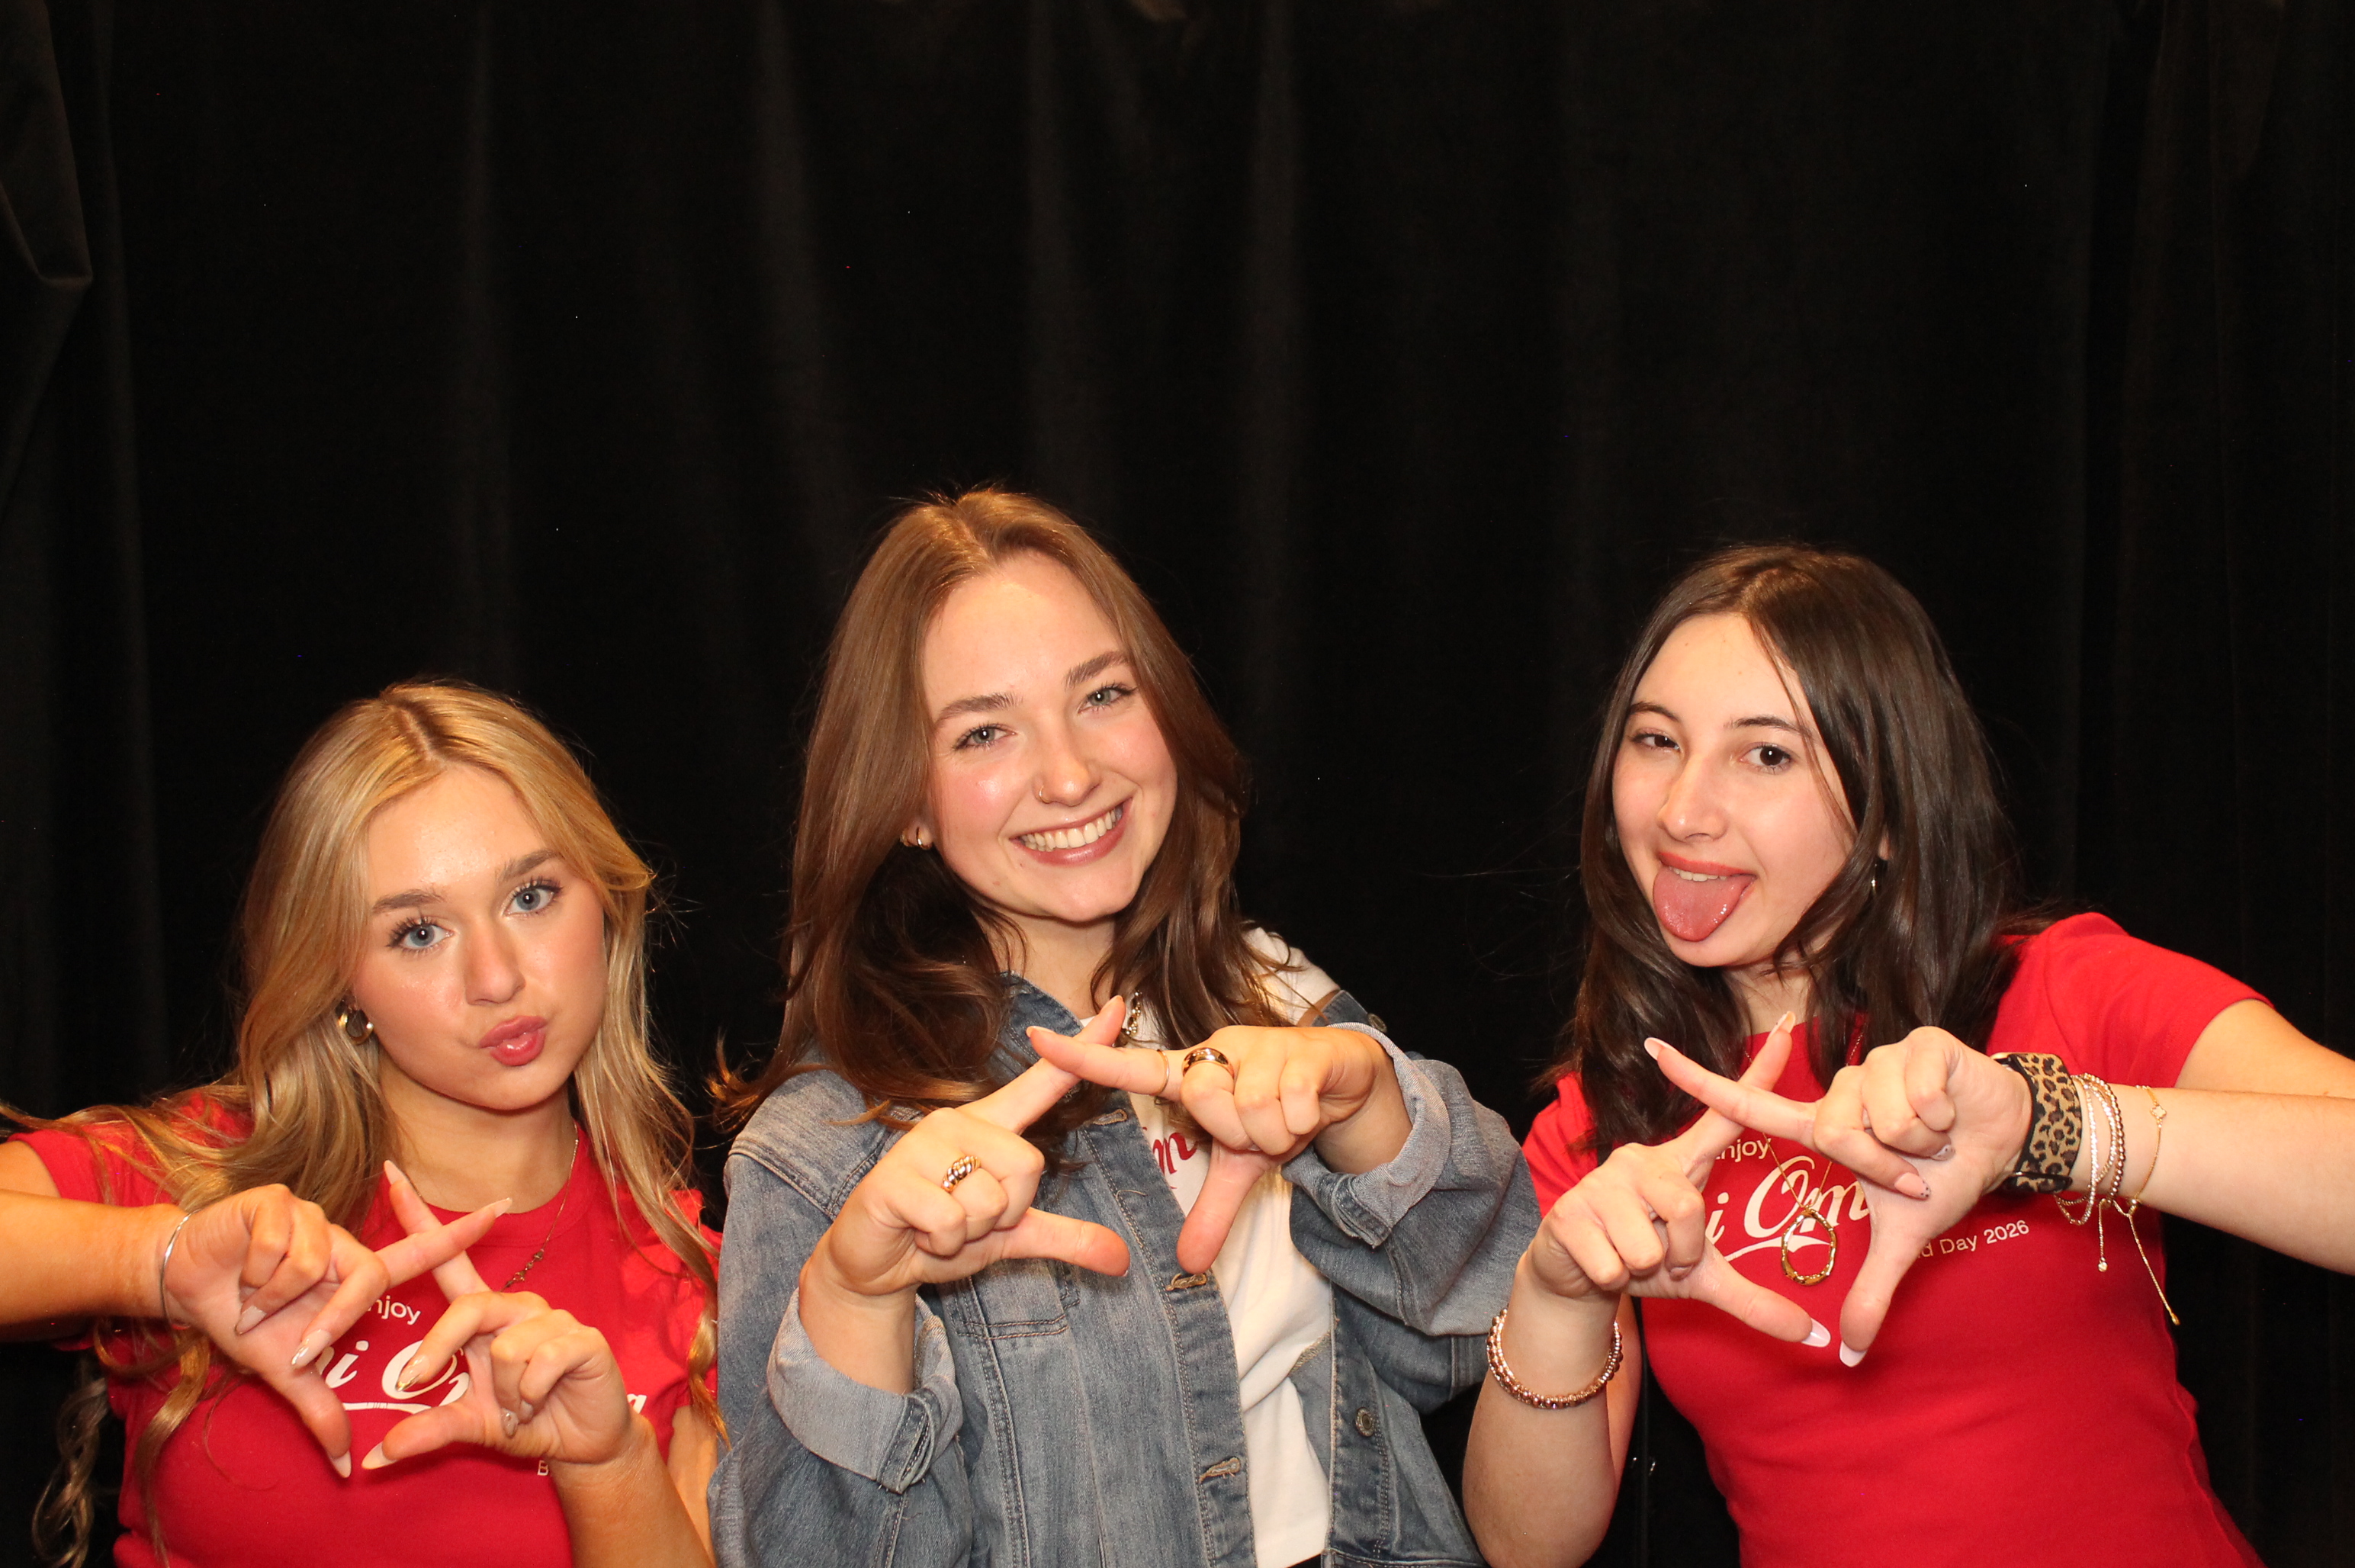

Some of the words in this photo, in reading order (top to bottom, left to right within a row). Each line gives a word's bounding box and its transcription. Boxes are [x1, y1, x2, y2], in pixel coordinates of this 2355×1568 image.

[1715, 1137, 1772, 1162] njoy
[1704, 1192, 1729, 1245] i
[1744, 1155, 1870, 1238] Om
[1918, 1242, 1933, 1258] d
[1939, 1235, 1977, 1255] Day
[1984, 1219, 2029, 1245] 2026
[368, 1295, 421, 1325] njoy
[537, 1460, 549, 1476] B
